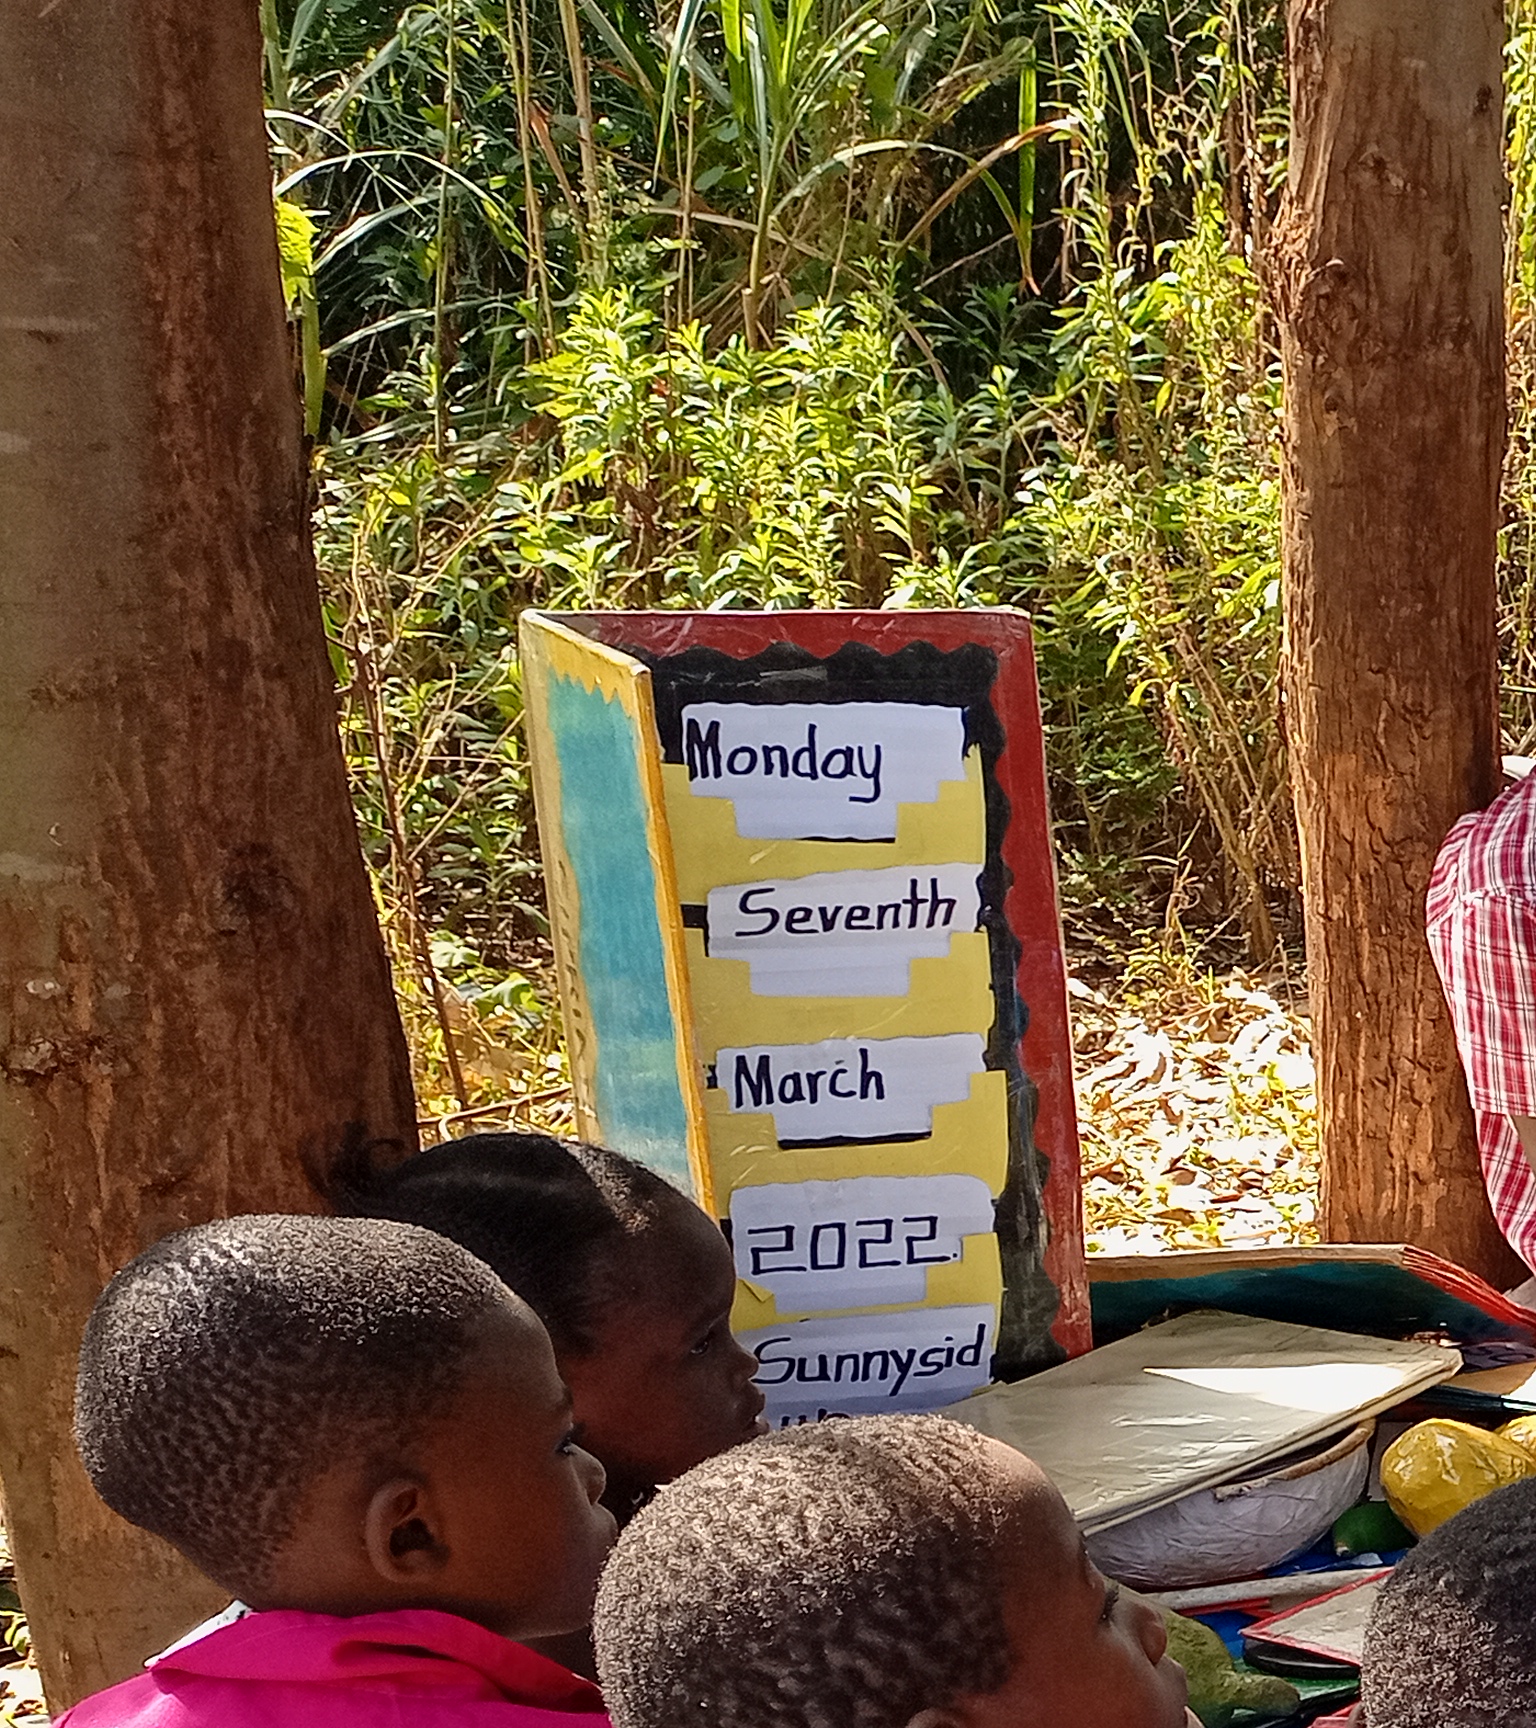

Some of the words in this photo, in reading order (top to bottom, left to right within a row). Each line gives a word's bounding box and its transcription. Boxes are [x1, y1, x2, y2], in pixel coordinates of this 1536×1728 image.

[687, 718, 881, 803] Monday
[735, 877, 957, 937] Seventh
[735, 1047, 885, 1109] March
[750, 1323, 986, 1397] Sunnysid
